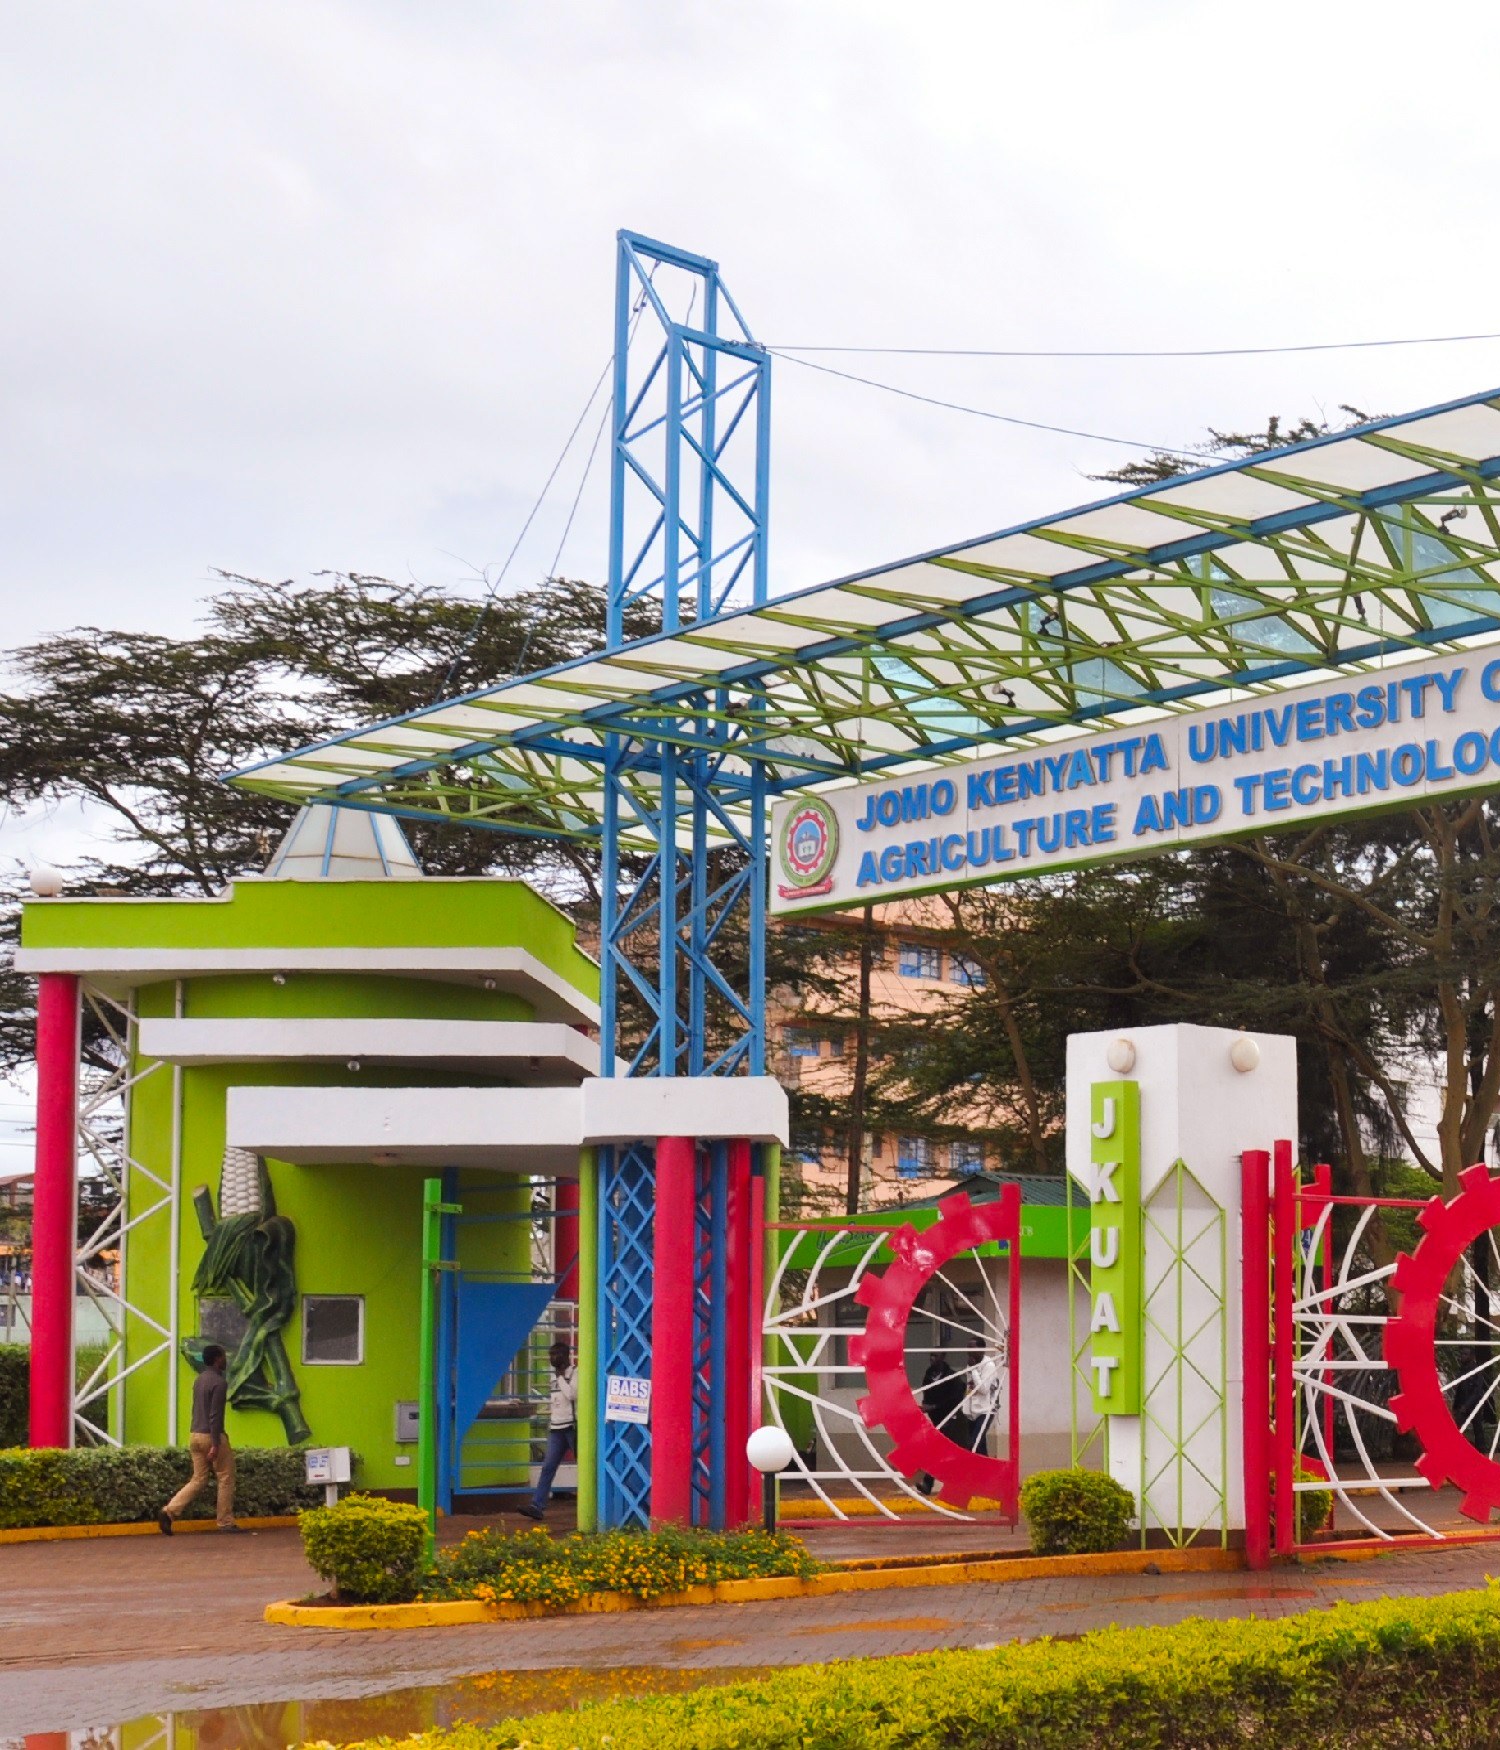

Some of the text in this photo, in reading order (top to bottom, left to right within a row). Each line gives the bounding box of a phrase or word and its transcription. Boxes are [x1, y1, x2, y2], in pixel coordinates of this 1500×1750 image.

[856, 779, 957, 832] JOMO
[967, 733, 1169, 809] KENYATTA
[1188, 667, 1467, 764] UNIVERSITY
[856, 803, 1118, 888] AGRICULTURE
[1132, 785, 1223, 834] AND
[1091, 1097, 1121, 1398] JKUAT
[610, 1380, 649, 1399] BABS
